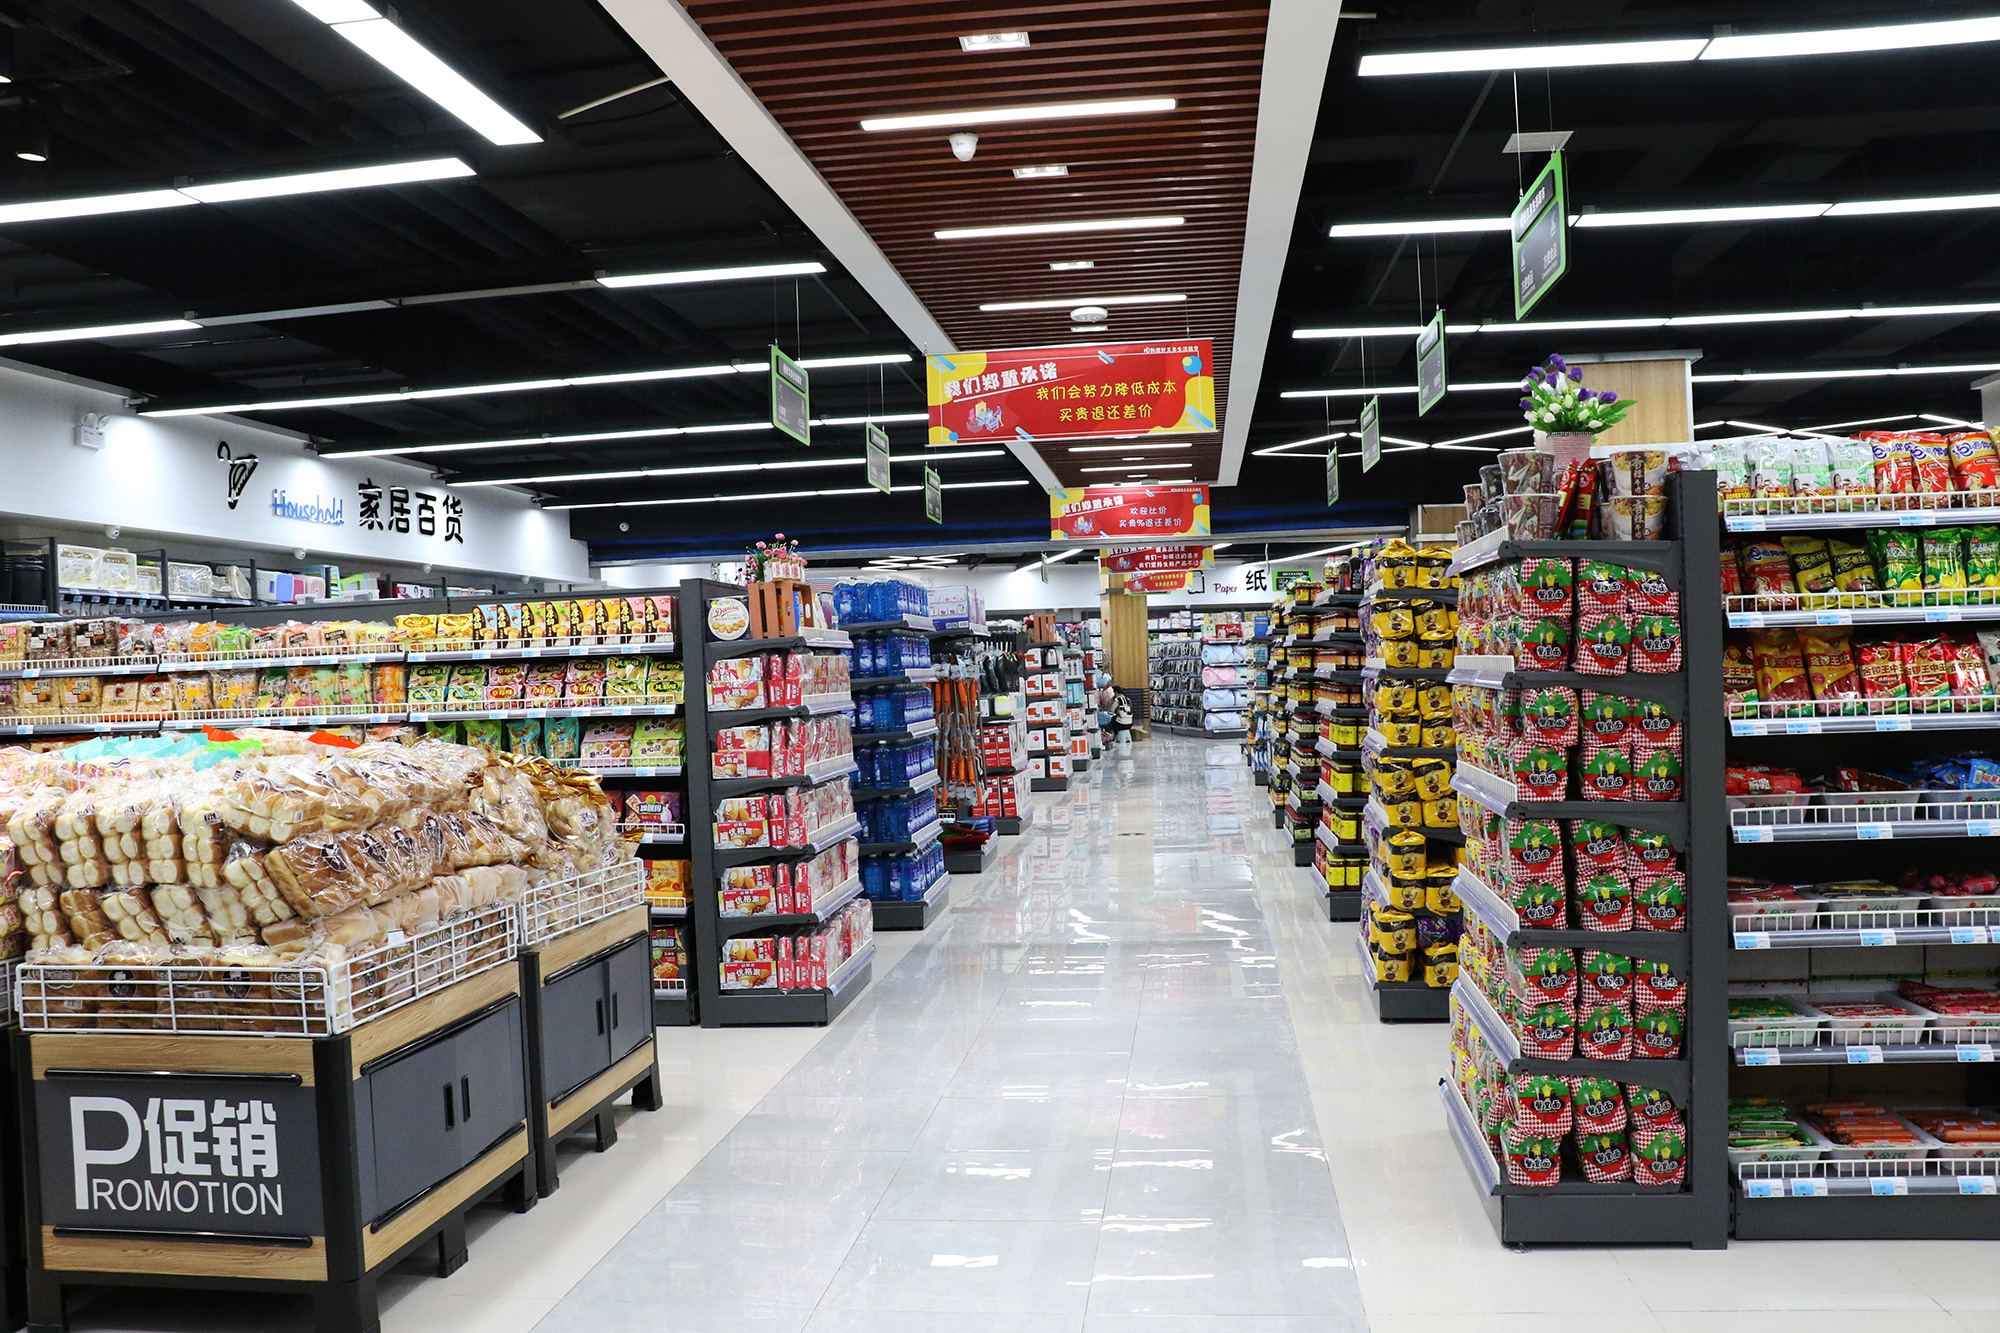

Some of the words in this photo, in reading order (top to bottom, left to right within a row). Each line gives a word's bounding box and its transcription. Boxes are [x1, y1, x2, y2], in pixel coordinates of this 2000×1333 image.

[943, 361, 1058, 399] 我们郑重承诺
[1035, 380, 1178, 400] 我们会努力降低成本
[1059, 404, 1153, 422] 买贵退还差价
[272, 489, 344, 525] Household
[358, 478, 463, 543] 家居百货
[1129, 506, 1167, 515] 欢迎比价
[1213, 583, 1238, 595] Paper
[1245, 569, 1268, 591] 纸
[143, 1097, 279, 1178] 促销
[70, 1096, 283, 1215] PROMOTION
